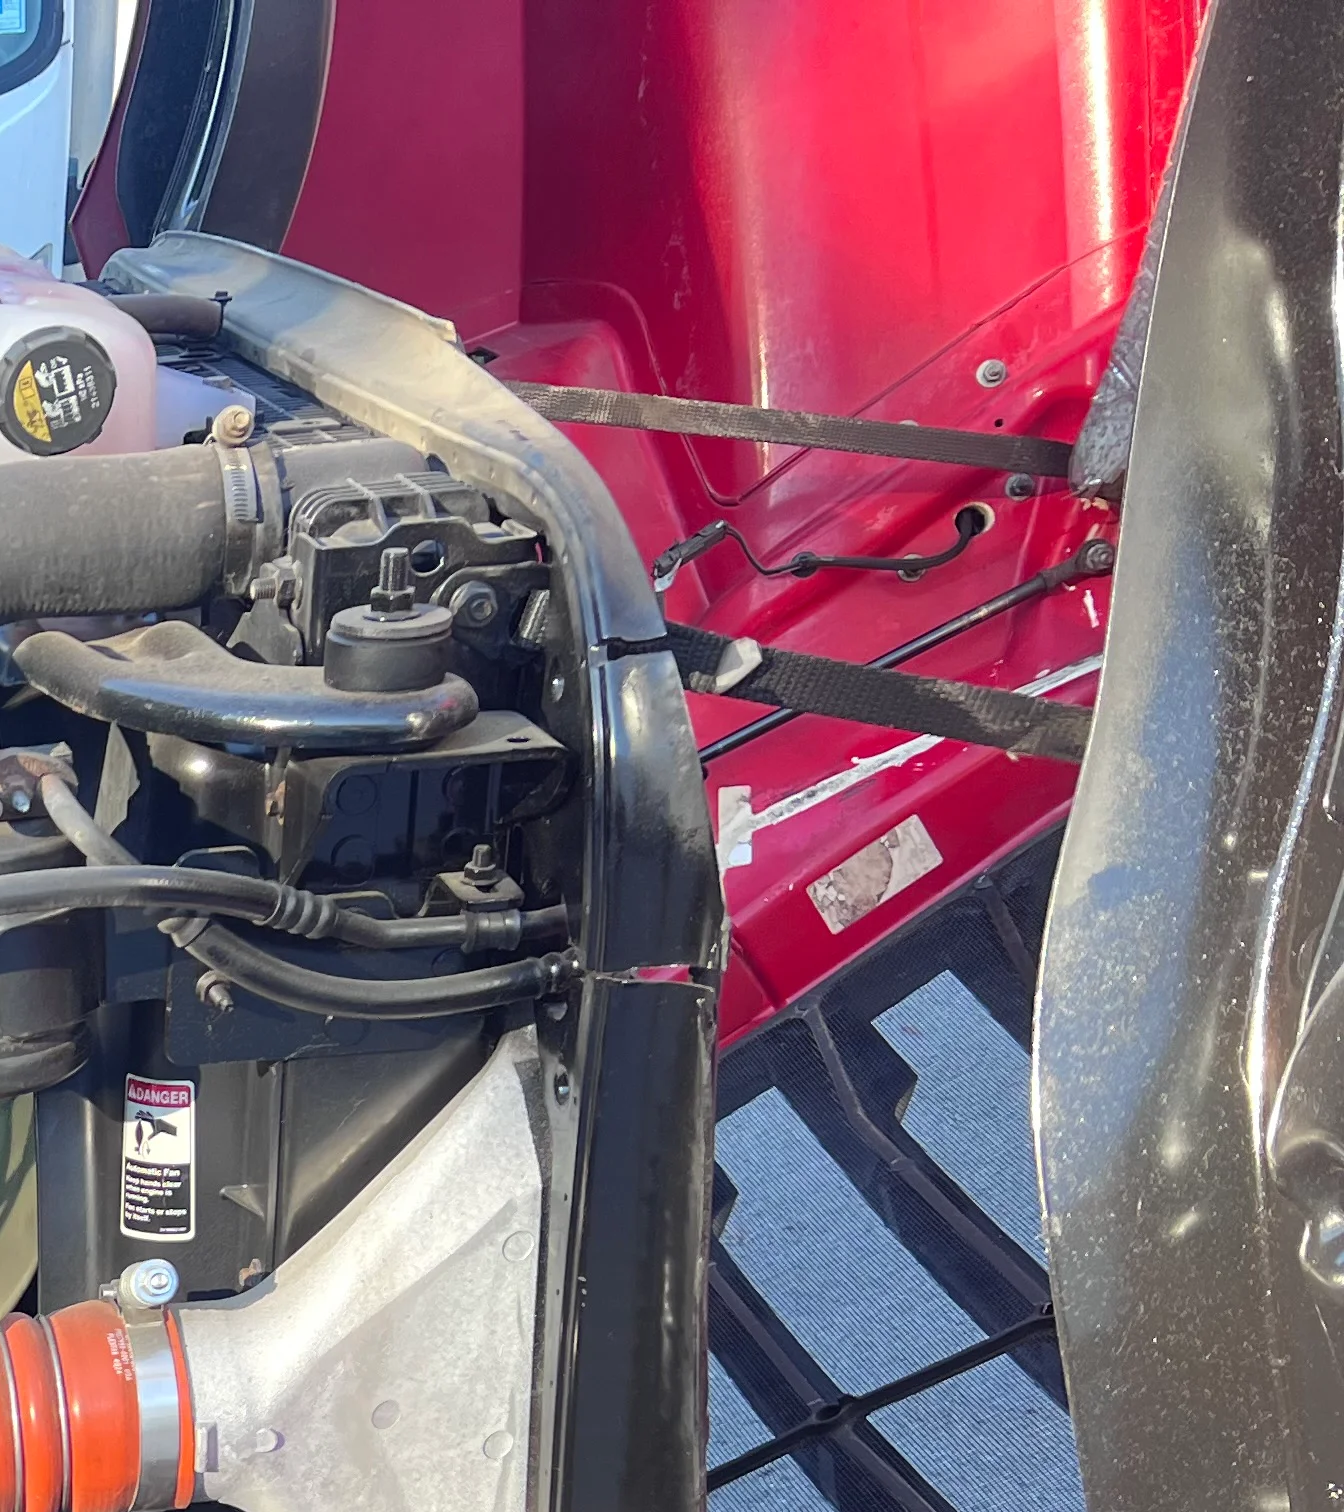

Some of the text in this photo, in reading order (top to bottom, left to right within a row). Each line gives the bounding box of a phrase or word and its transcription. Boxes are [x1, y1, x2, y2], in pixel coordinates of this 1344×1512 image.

[134, 1086, 189, 1105] DANGER
[126, 1162, 181, 1177] Automatic Fan
[125, 1174, 140, 1185] Keep
[140, 1178, 161, 1187] hands
[140, 1188, 164, 1197] engine
[135, 1206, 156, 1215] starts
[165, 1208, 188, 1217] stops
